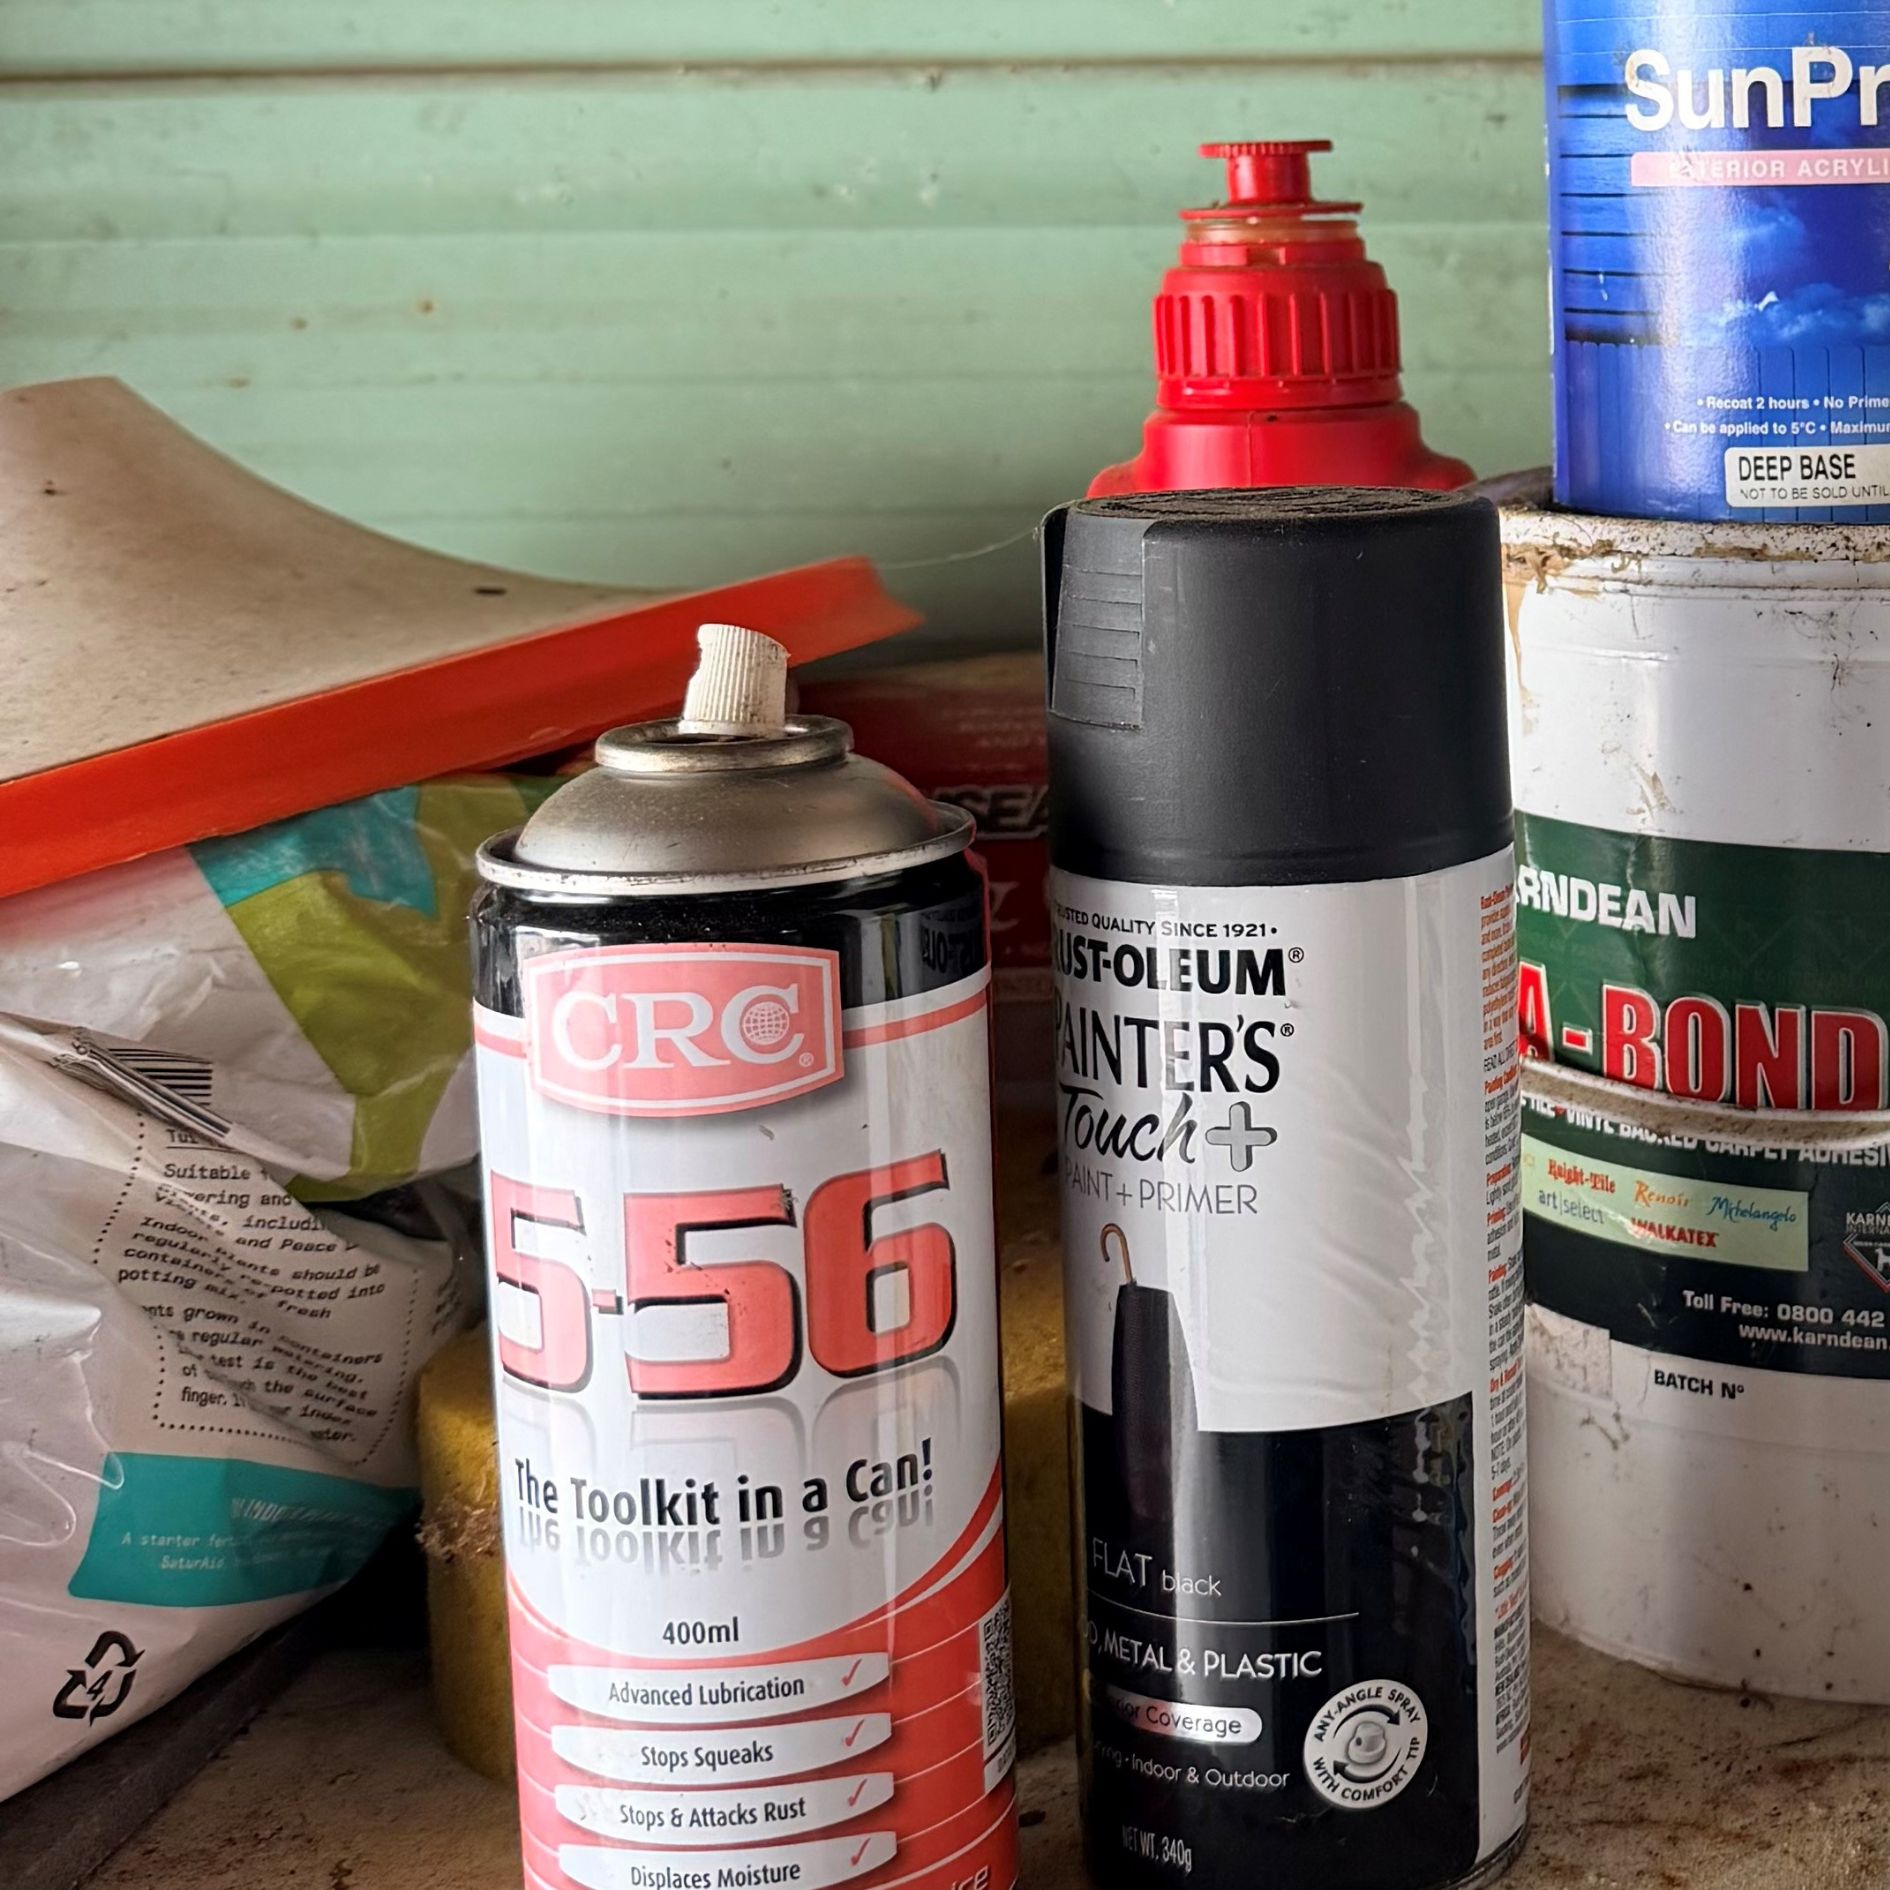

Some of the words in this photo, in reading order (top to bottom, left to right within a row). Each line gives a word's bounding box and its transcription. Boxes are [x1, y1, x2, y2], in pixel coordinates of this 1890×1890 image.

[1706, 396, 1753, 409] Recoat
[1757, 397, 1765, 409] 2
[1769, 397, 1810, 409] hours
[1824, 396, 1843, 408] No
[1673, 420, 1697, 434] Can
[1701, 421, 1716, 434] be
[1720, 420, 1769, 437] applied
[1772, 421, 1787, 434] to
[1738, 456, 1792, 481] DEEP
[1801, 454, 1856, 480] BASE
[1770, 488, 1788, 500] TO
[1792, 487, 1808, 499] BE
[1813, 485, 1847, 499] SOLD
[1852, 484, 1889, 498] UNTIL
[1516, 864, 1696, 939] RNDEAN
[1054, 928, 1286, 997] UST-OLEUM
[553, 983, 806, 1072] CRC
[1060, 1082, 1197, 1164] Touch
[164, 1163, 251, 1180] Suitable
[260, 1192, 292, 1206] and
[1682, 1290, 1714, 1310] Toll
[1721, 1296, 1768, 1318] Free:
[1778, 1304, 1833, 1324] 0800
[1842, 1310, 1884, 1328] 442
[1654, 1369, 1713, 1396] BATCH
[515, 1458, 558, 1513] The
[570, 1476, 720, 1527] Toolkit
[737, 1474, 783, 1520] in
[802, 1477, 828, 1513] a
[846, 1438, 933, 1502] Can!
[1093, 1537, 1152, 1587] FLAT
[1162, 1570, 1222, 1596] black
[662, 1617, 739, 1645] 400ml
[1104, 1628, 1173, 1672] METAL
[1177, 1649, 1195, 1675] &
[1204, 1650, 1322, 1679] PLASTIC
[86, 1670, 112, 1701] 4
[609, 1682, 693, 1706] Advanced
[699, 1677, 805, 1704] Lubrication
[1147, 1706, 1241, 1737] Coverage
[1314, 1687, 1383, 1742] ANY-ANGLE
[1388, 1689, 1420, 1723] SPRAY
[641, 1745, 689, 1771] Stops
[695, 1741, 775, 1768] Squeaks
[1313, 1757, 1340, 1792] WITH
[1342, 1765, 1408, 1800] COMFORT
[1406, 1737, 1420, 1760] TIP
[620, 1804, 667, 1830] Stops
[671, 1807, 683, 1828] &
[688, 1802, 757, 1827] Attacks
[764, 1796, 806, 1822] Rust
[630, 1865, 712, 1890] Displaces
[717, 1860, 801, 1887] Moisture
